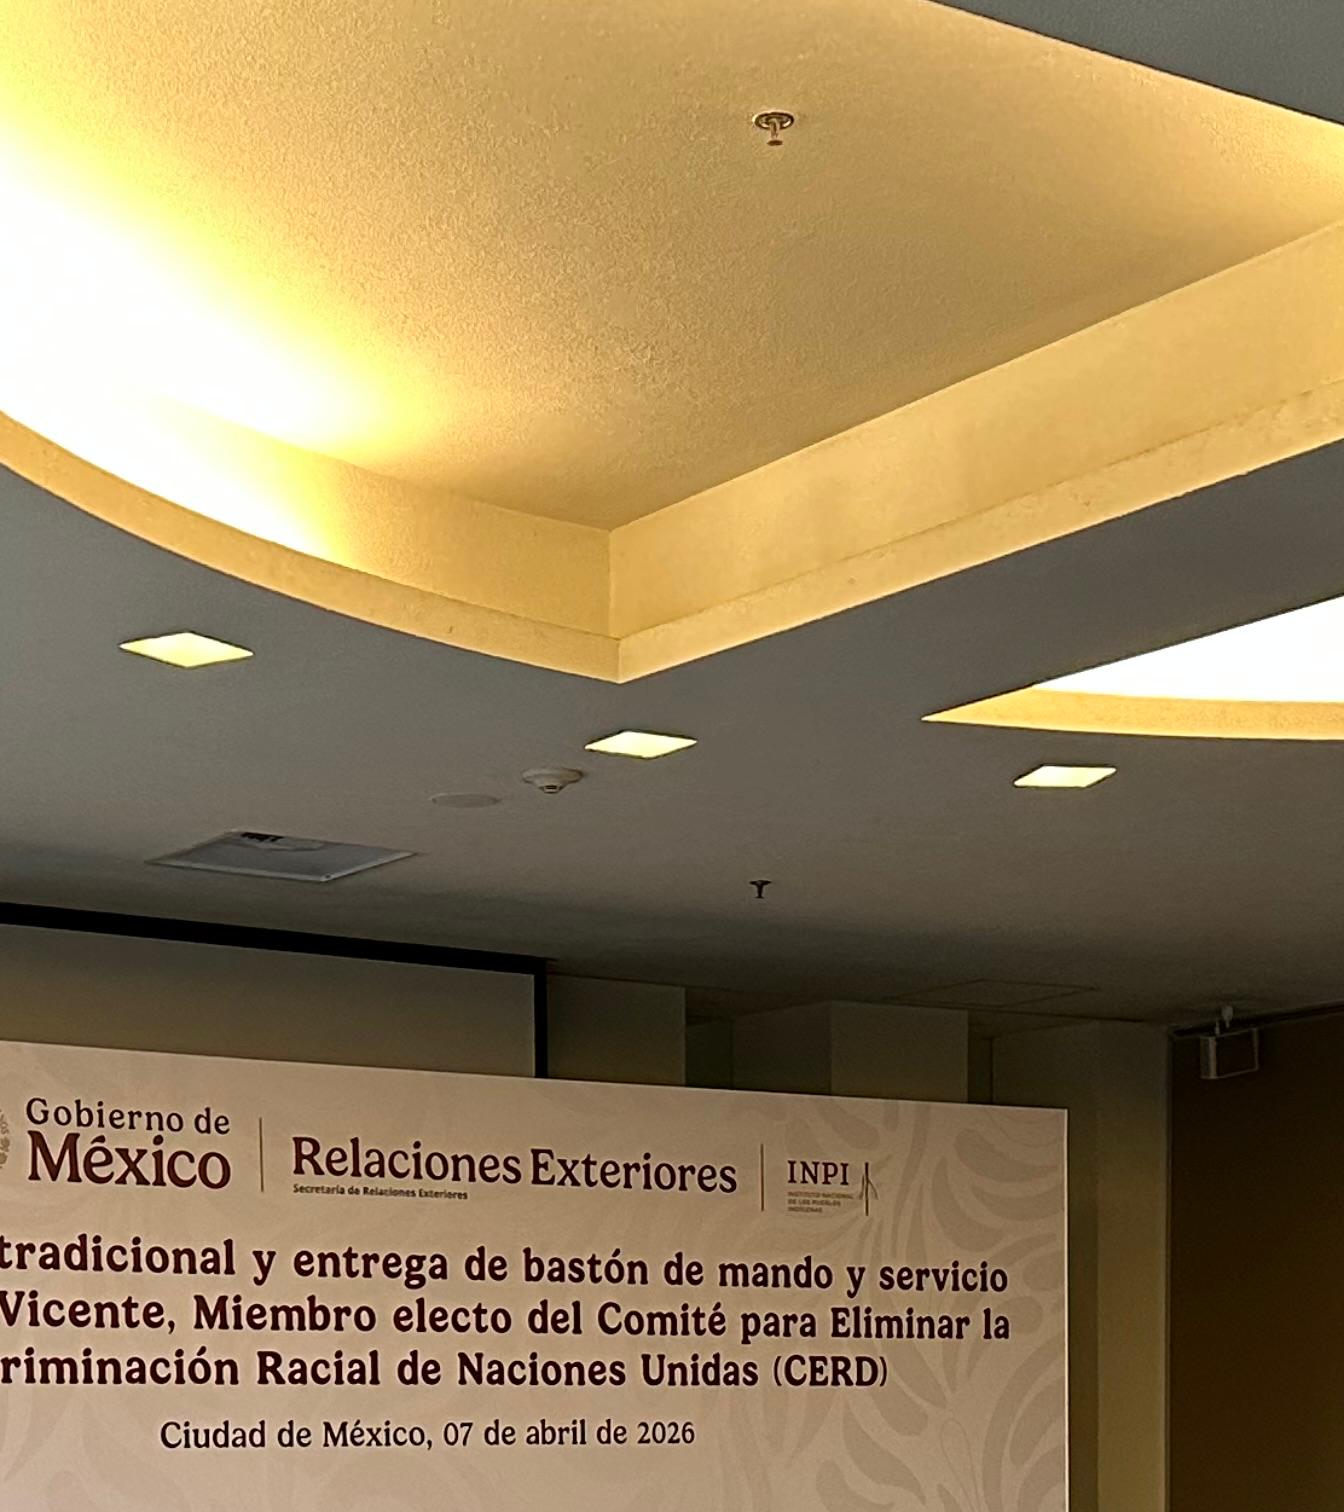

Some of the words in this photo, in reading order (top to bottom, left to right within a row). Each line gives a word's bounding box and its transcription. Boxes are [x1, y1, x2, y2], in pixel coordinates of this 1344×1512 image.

[25, 1097, 184, 1133] Gobierno
[193, 1106, 231, 1136] de
[26, 1129, 232, 1190] México
[291, 1136, 522, 1185] Relaciones
[530, 1148, 738, 1194] Exteriores
[787, 1159, 850, 1186] INPI
[347, 1185, 361, 1195] de
[363, 1186, 416, 1198] Relaciones
[418, 1188, 469, 1200] Exteriores
[251, 1250, 277, 1287] y
[293, 1246, 448, 1291] entrega
[464, 1245, 508, 1282] de
[522, 1246, 649, 1286] bastón
[663, 1251, 705, 1287] de
[718, 1255, 834, 1290] mando
[846, 1266, 867, 1300] y
[878, 1259, 1008, 1293] servicio
[193, 1293, 377, 1333] Miembro
[392, 1296, 512, 1334] electo
[527, 1298, 583, 1336] del
[597, 1301, 727, 1337] Comité
[740, 1311, 817, 1346] para
[830, 1305, 971, 1340] Eliminar
[982, 1307, 1010, 1340] la
[256, 1349, 381, 1386] Racial
[397, 1349, 442, 1386] de
[457, 1351, 627, 1387] Naciones
[640, 1351, 759, 1387] Unidas
[773, 1354, 888, 1388] (CERD)
[160, 1419, 266, 1449] Ciudad
[277, 1419, 313, 1448] de
[322, 1418, 433, 1452] México,
[443, 1421, 474, 1447] 07
[483, 1418, 517, 1447] de
[525, 1418, 587, 1446] abril
[596, 1418, 628, 1445] de
[636, 1421, 696, 1445] 2026
